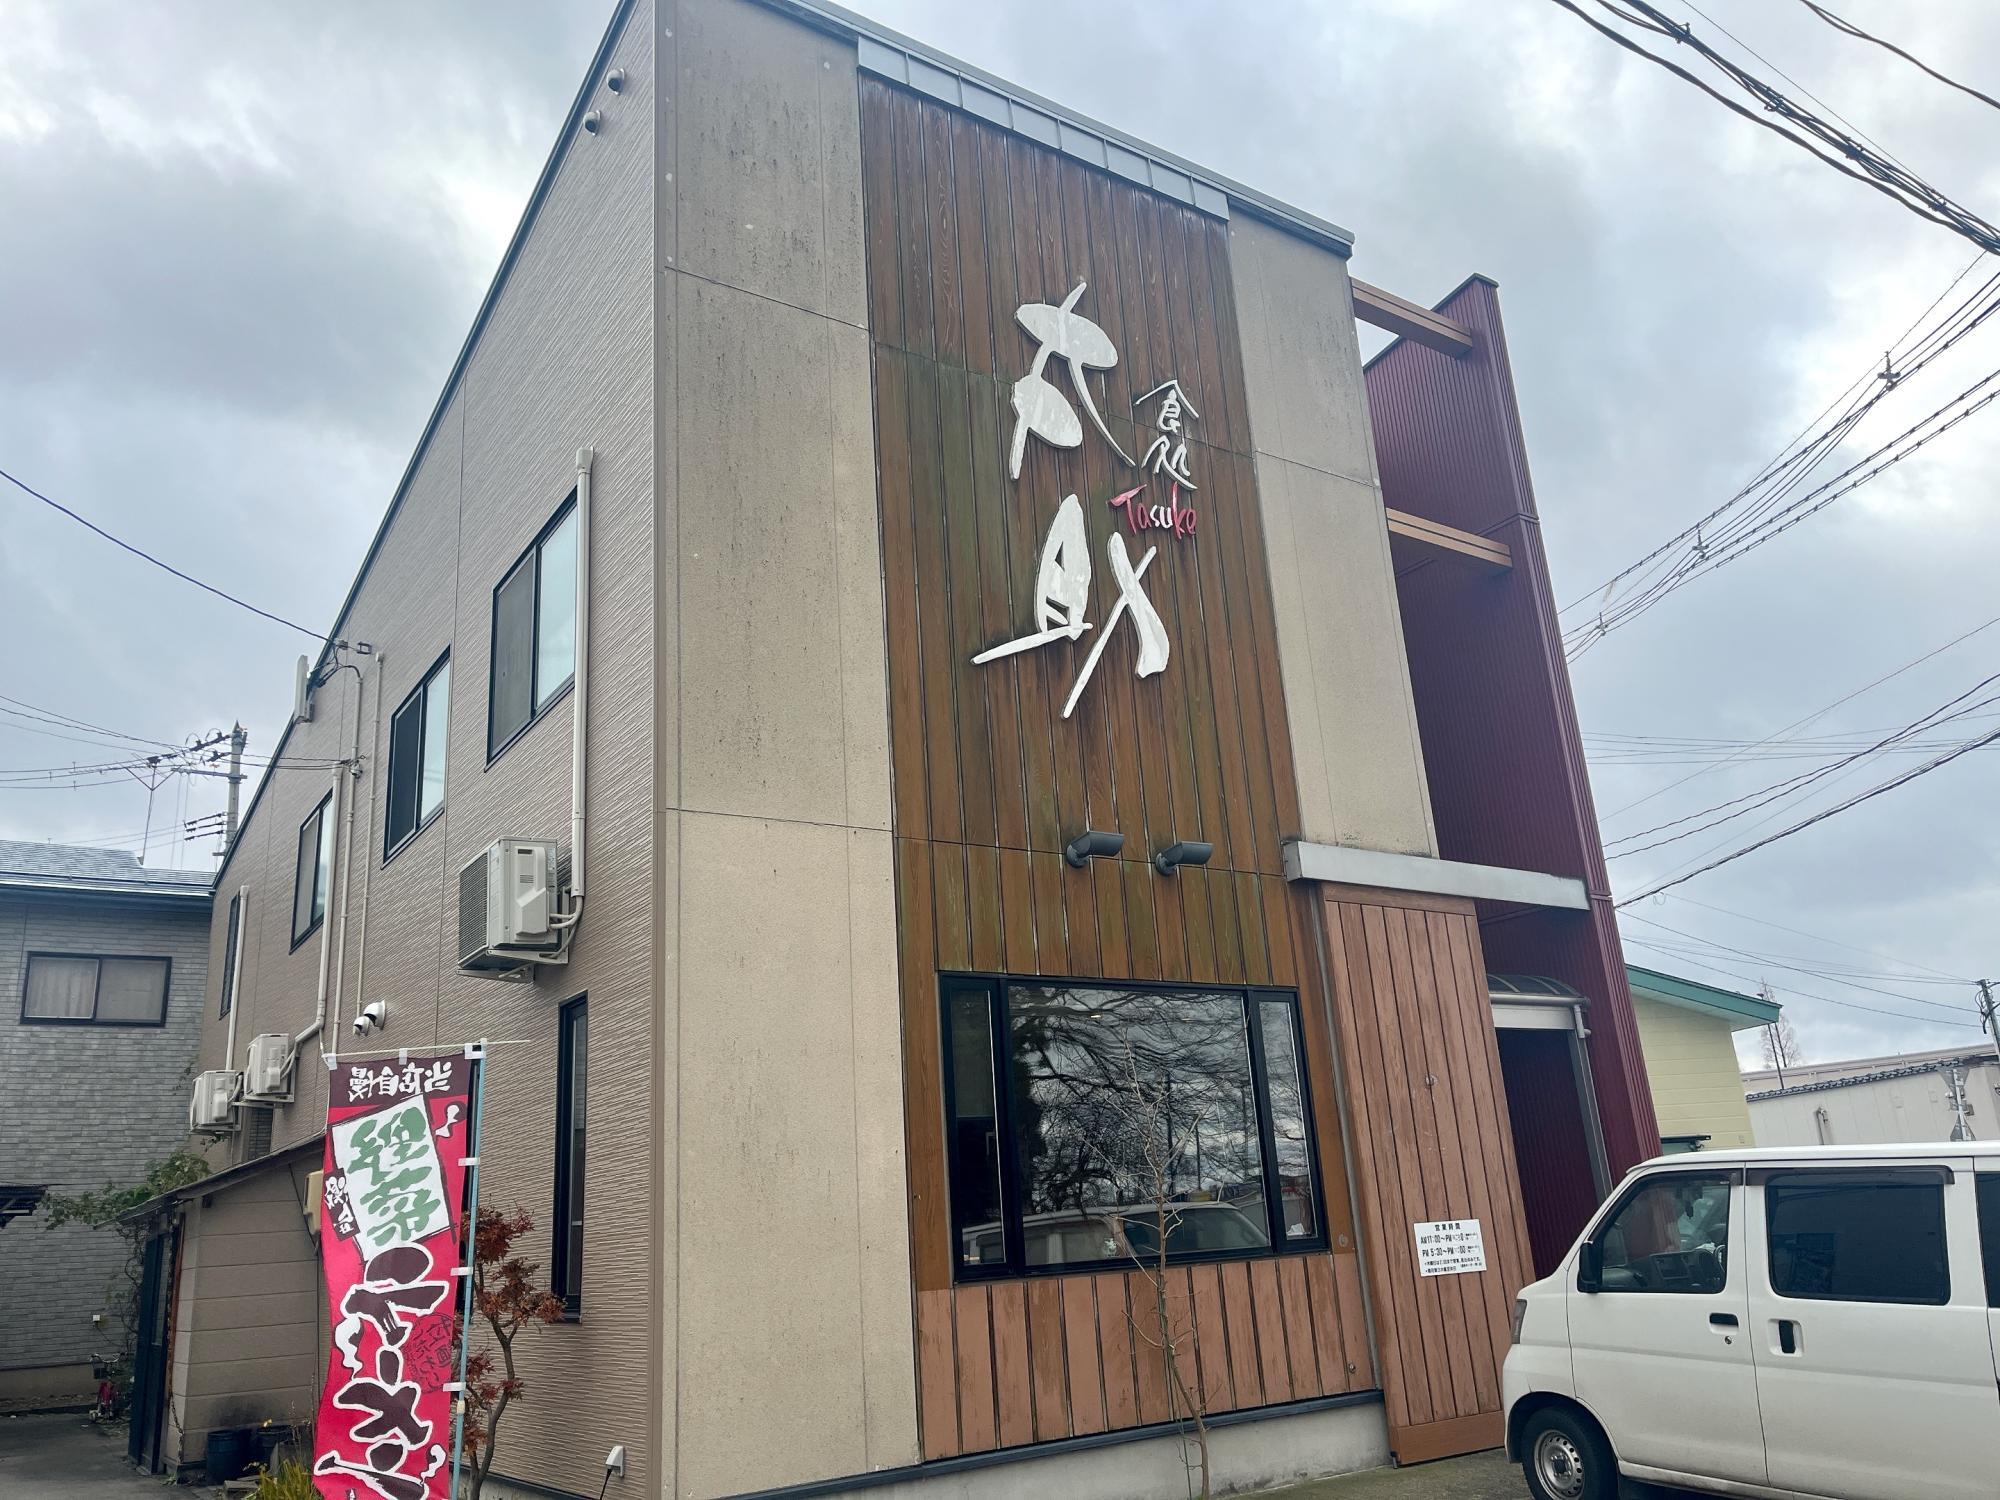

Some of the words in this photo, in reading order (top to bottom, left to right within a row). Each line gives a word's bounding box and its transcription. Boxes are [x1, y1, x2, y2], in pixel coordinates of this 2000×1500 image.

[1134, 379, 1199, 491] 食処
[1106, 481, 1198, 544] Tasuke
[1435, 1223, 1460, 1231] 営業時間
